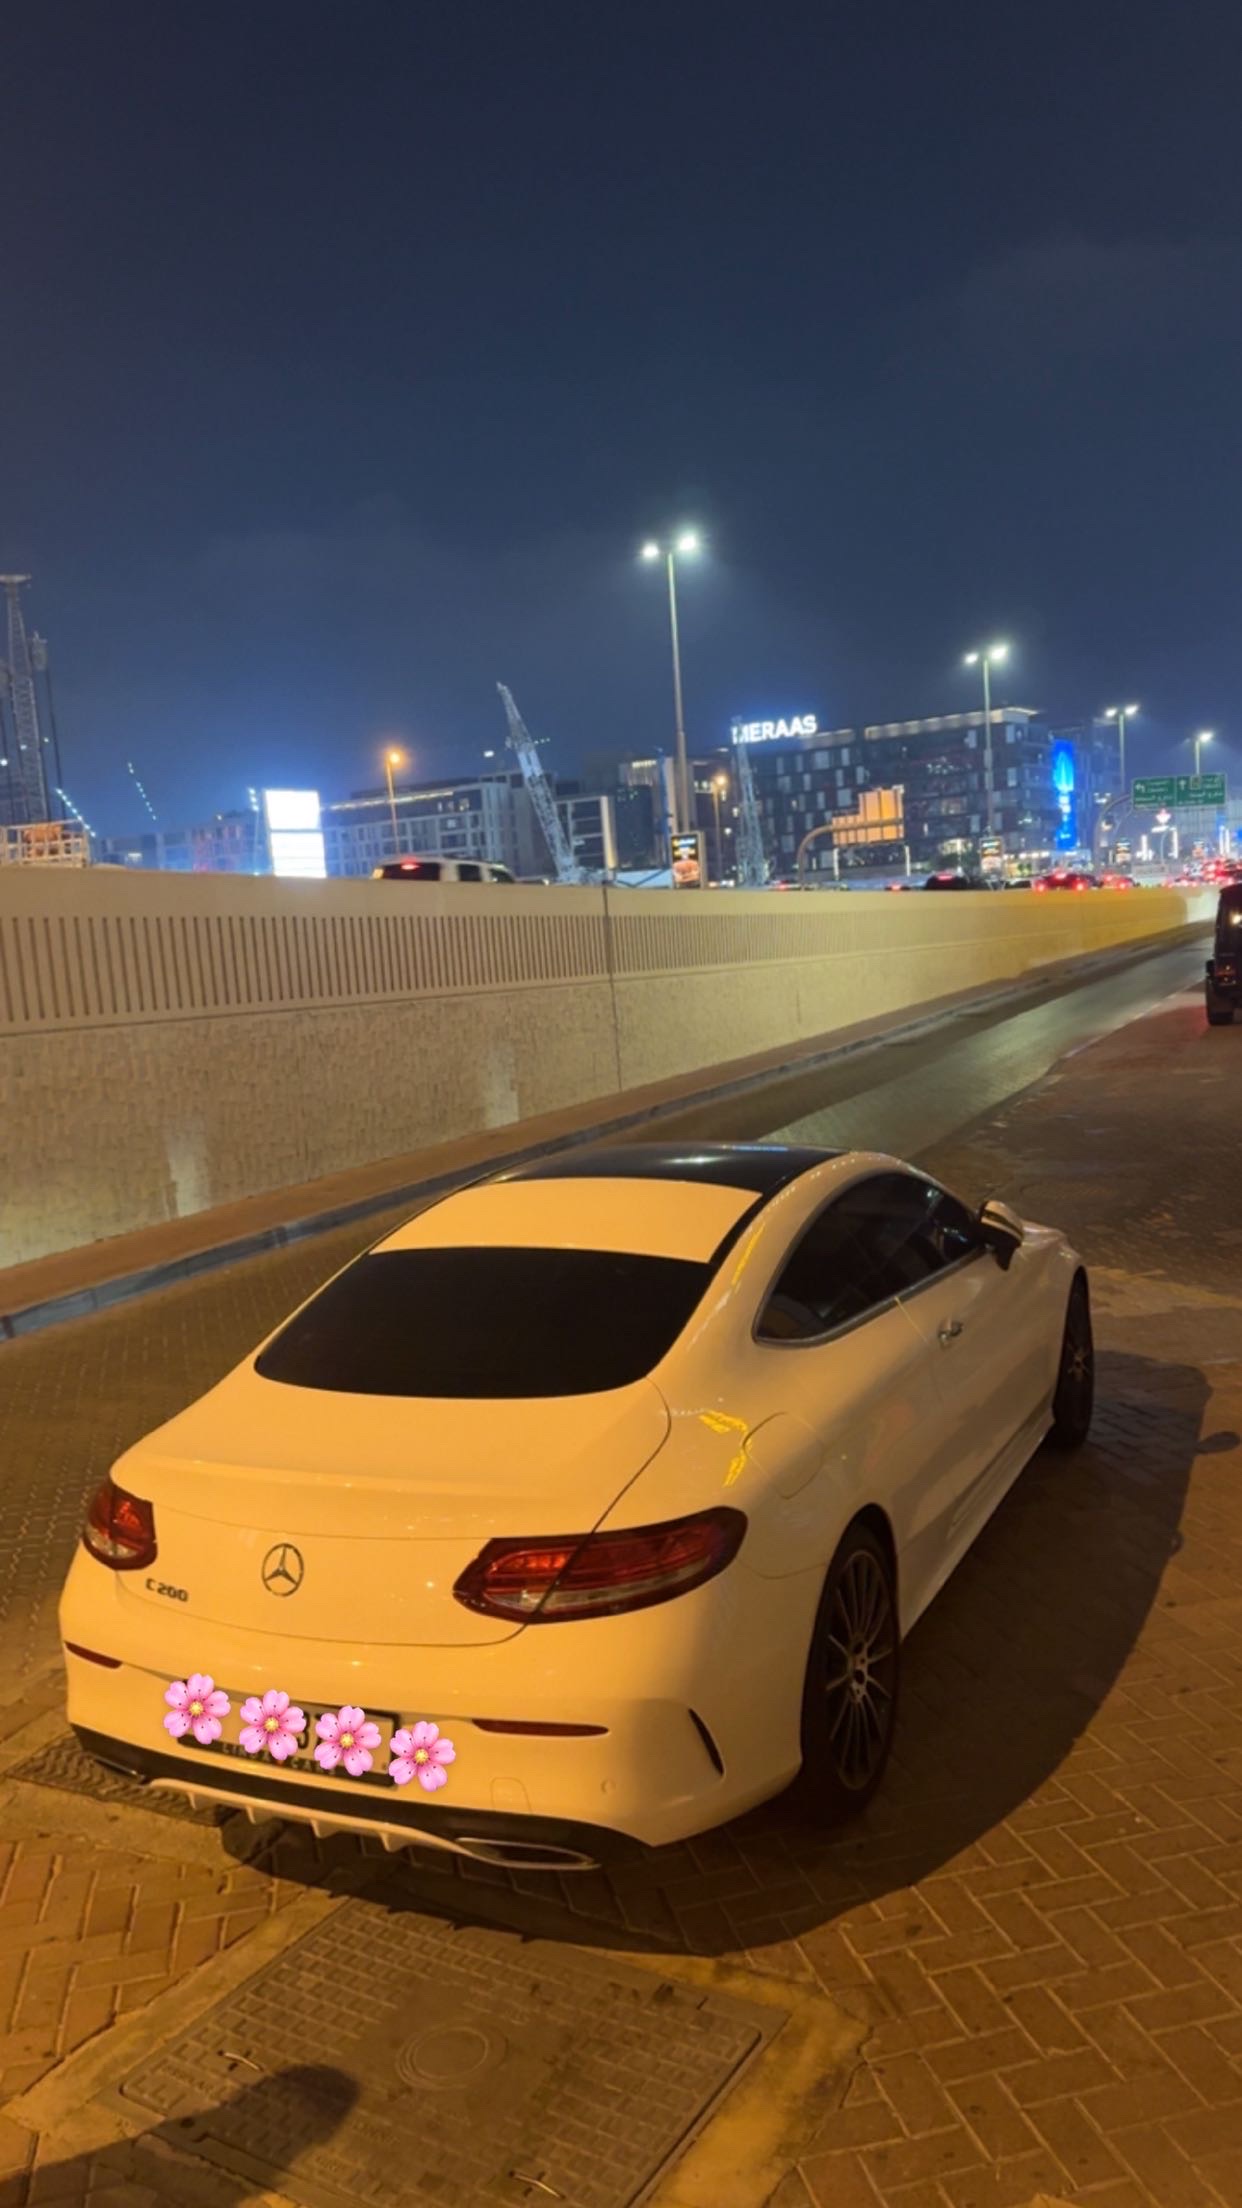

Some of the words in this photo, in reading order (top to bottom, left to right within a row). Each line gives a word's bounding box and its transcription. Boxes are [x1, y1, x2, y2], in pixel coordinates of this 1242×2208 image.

[731, 714, 818, 744] MERAAS
[145, 1577, 156, 1591] C
[157, 1582, 189, 1602] 200
